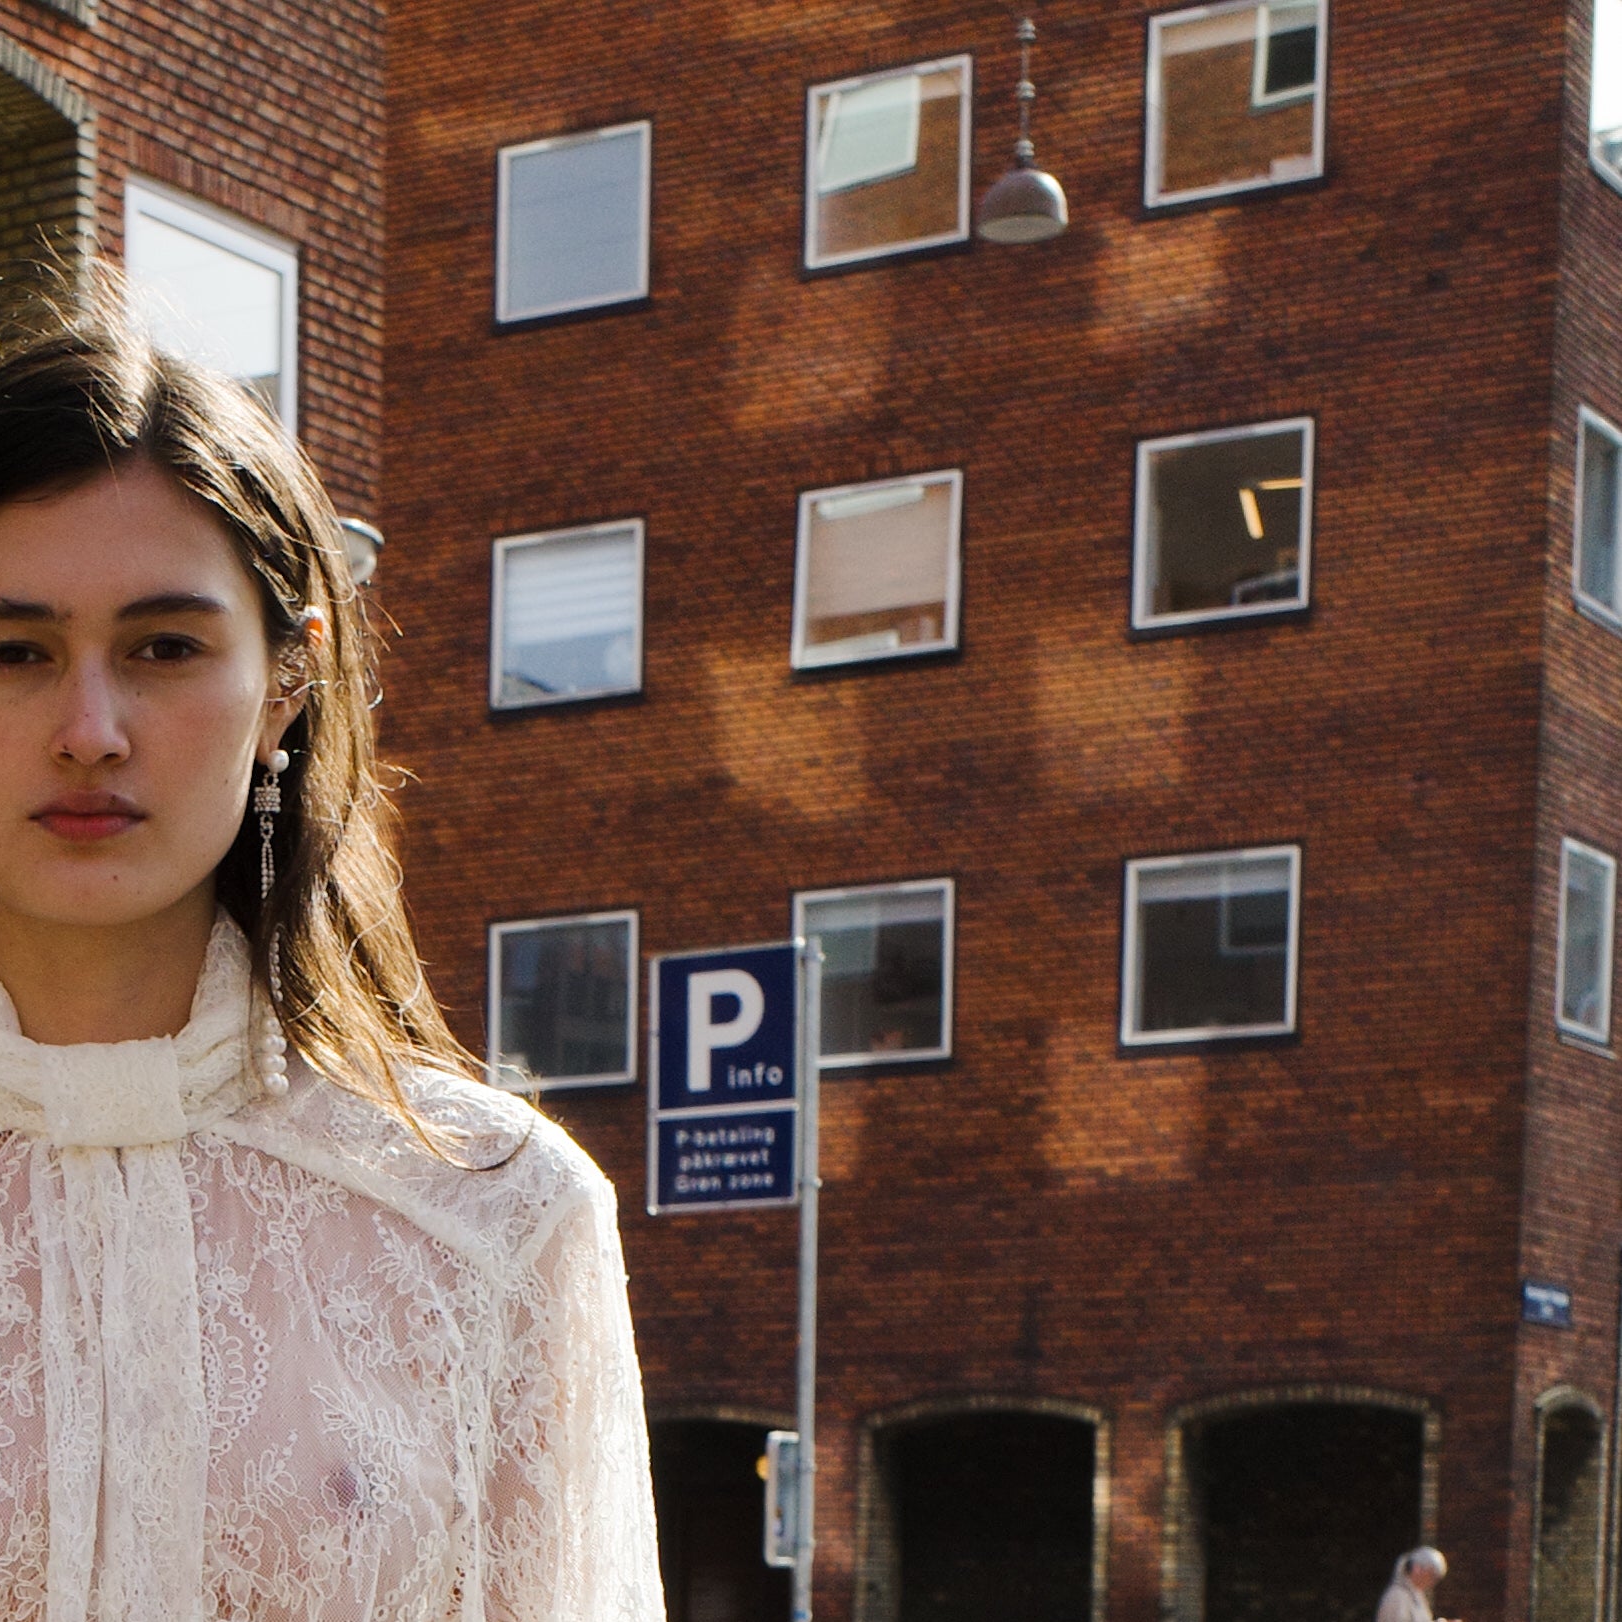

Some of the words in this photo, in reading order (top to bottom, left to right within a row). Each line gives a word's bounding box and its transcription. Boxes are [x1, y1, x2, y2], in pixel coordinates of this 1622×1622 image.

[687, 968, 765, 1092] P
[728, 1062, 784, 1089] info
[729, 1172, 775, 1190] zone
